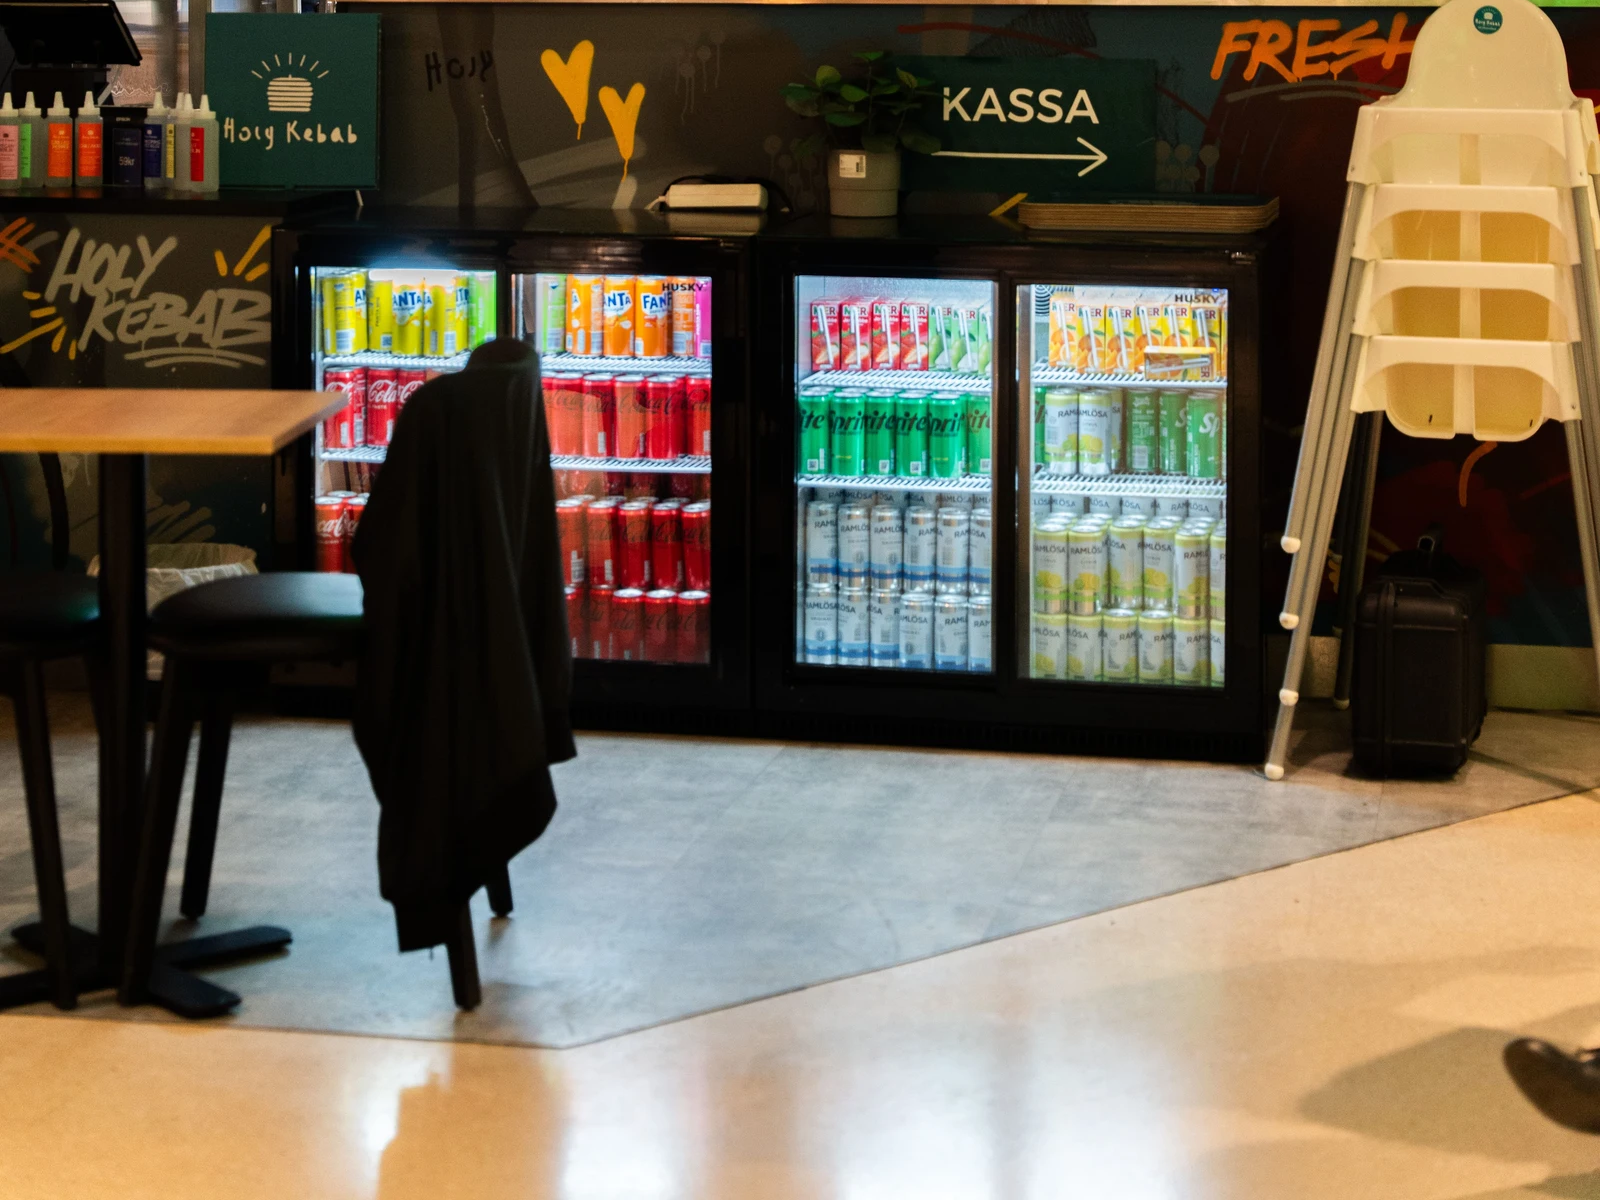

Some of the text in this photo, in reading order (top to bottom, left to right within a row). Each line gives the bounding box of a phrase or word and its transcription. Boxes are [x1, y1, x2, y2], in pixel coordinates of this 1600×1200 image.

[943, 86, 1100, 124] KASSA
[223, 116, 274, 151] Holy
[286, 119, 358, 144] Kebab
[44, 227, 178, 303] HOLY
[392, 290, 422, 307] ANTA
[662, 283, 704, 292] HUSKY
[1174, 293, 1219, 304] HUSKY
[77, 287, 272, 352] KEBAB
[1079, 409, 1108, 418] AMLÖSA
